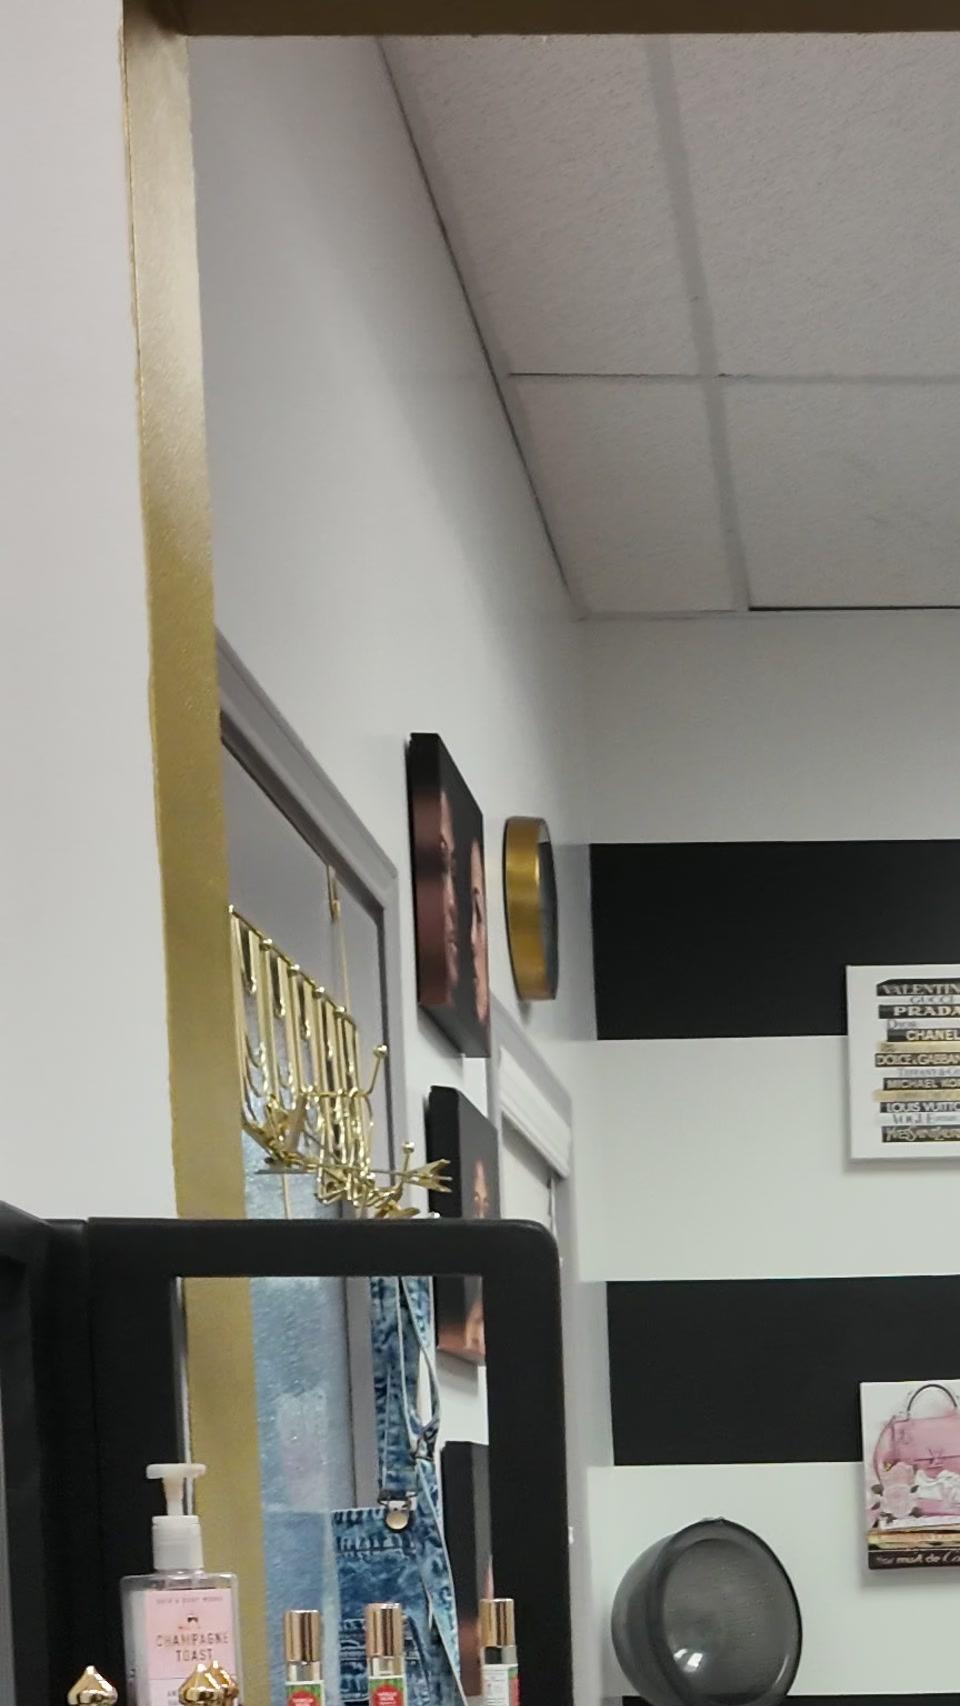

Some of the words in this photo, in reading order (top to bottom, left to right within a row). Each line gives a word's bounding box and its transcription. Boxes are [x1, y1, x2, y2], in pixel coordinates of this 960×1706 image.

[886, 1079, 938, 1090] MICHAEL
[887, 1102, 920, 1113] LOUIS
[155, 1632, 229, 1648] CHAMPAGNE
[175, 1648, 213, 1662] TOAST
